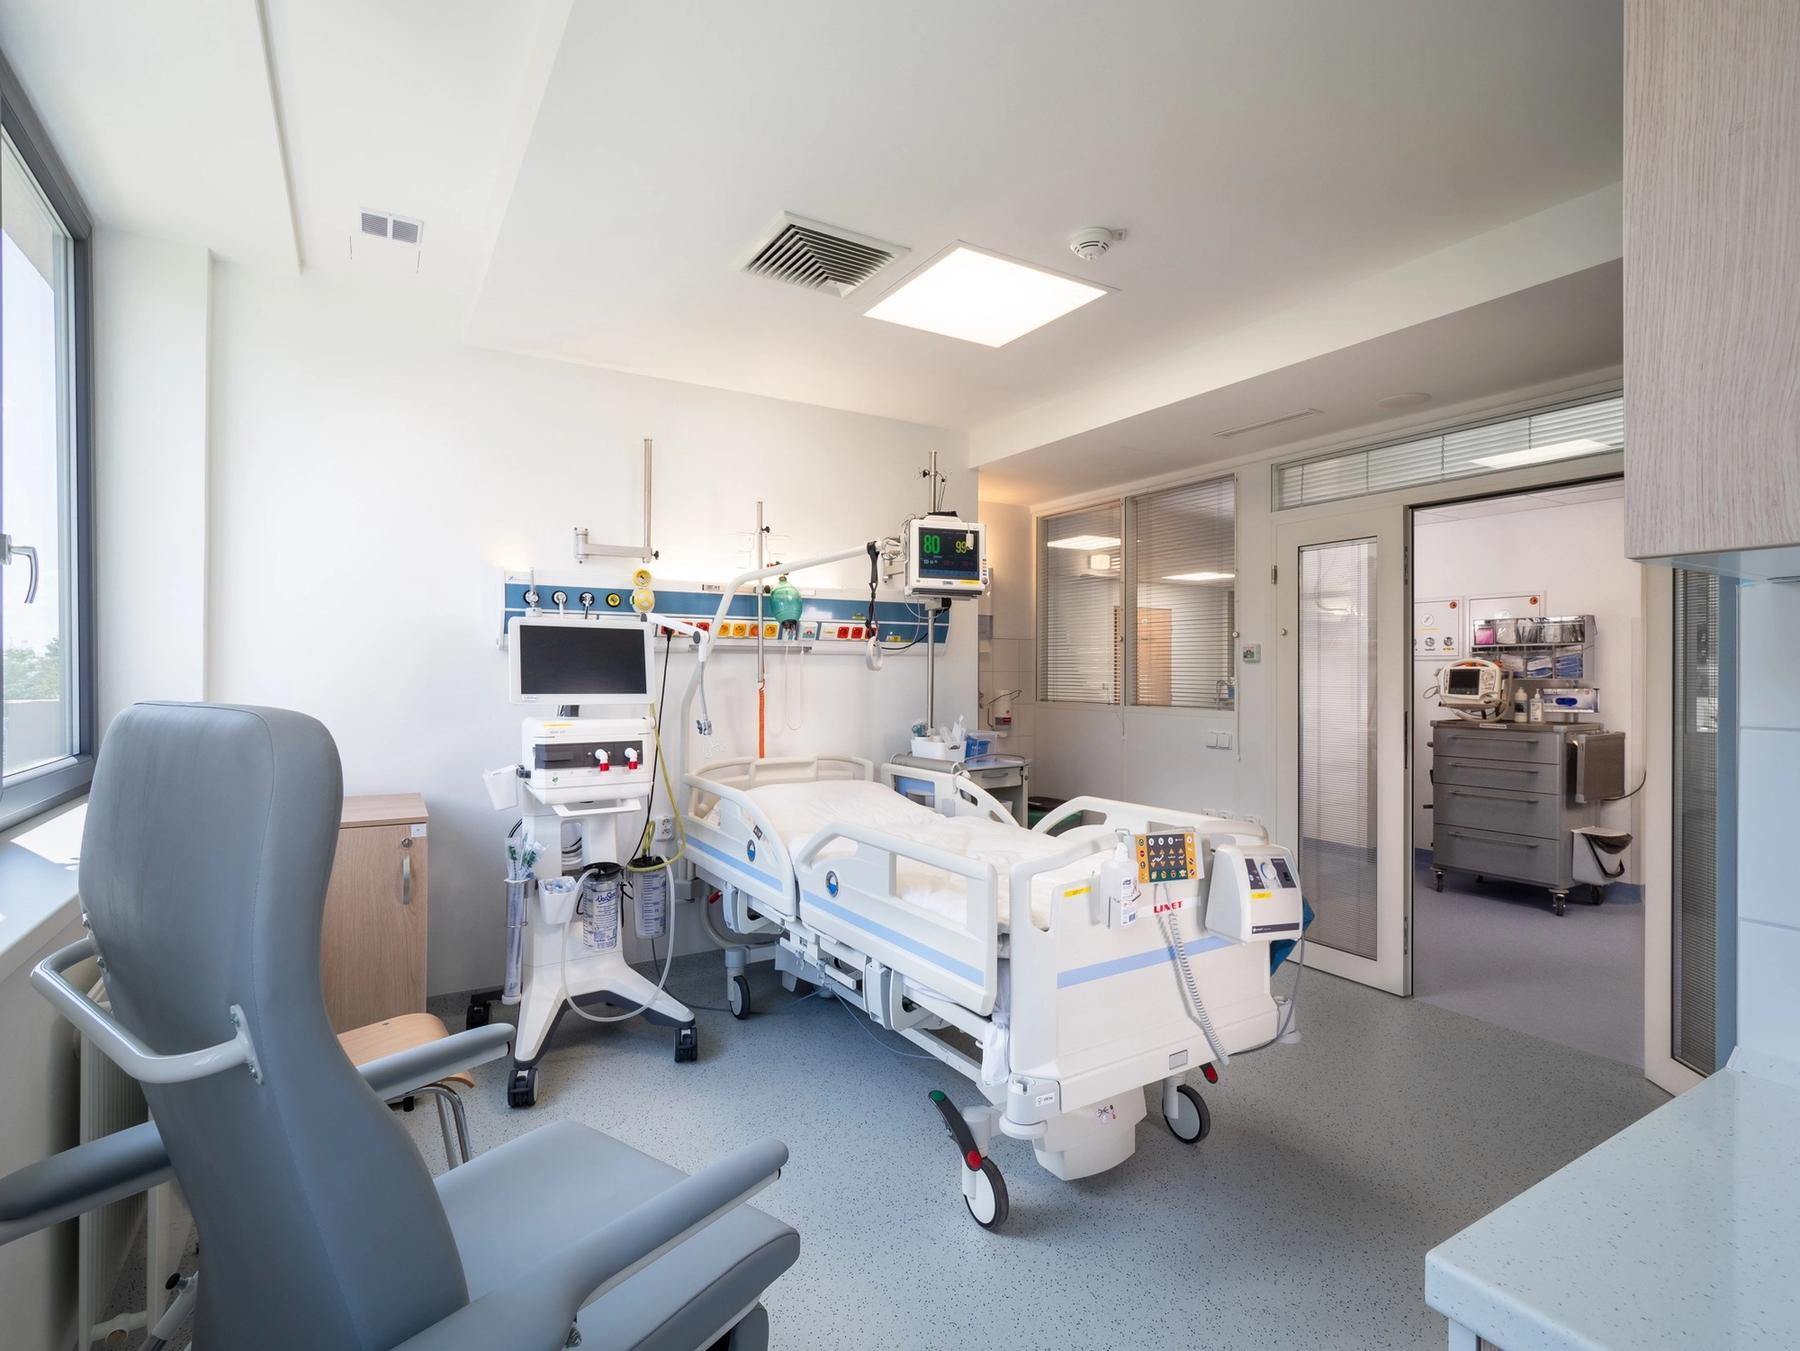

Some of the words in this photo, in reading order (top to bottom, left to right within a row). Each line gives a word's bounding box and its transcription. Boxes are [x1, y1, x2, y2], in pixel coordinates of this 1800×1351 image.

[924, 535, 940, 554] 80
[955, 541, 967, 553] 99
[1154, 901, 1183, 913] LINET
